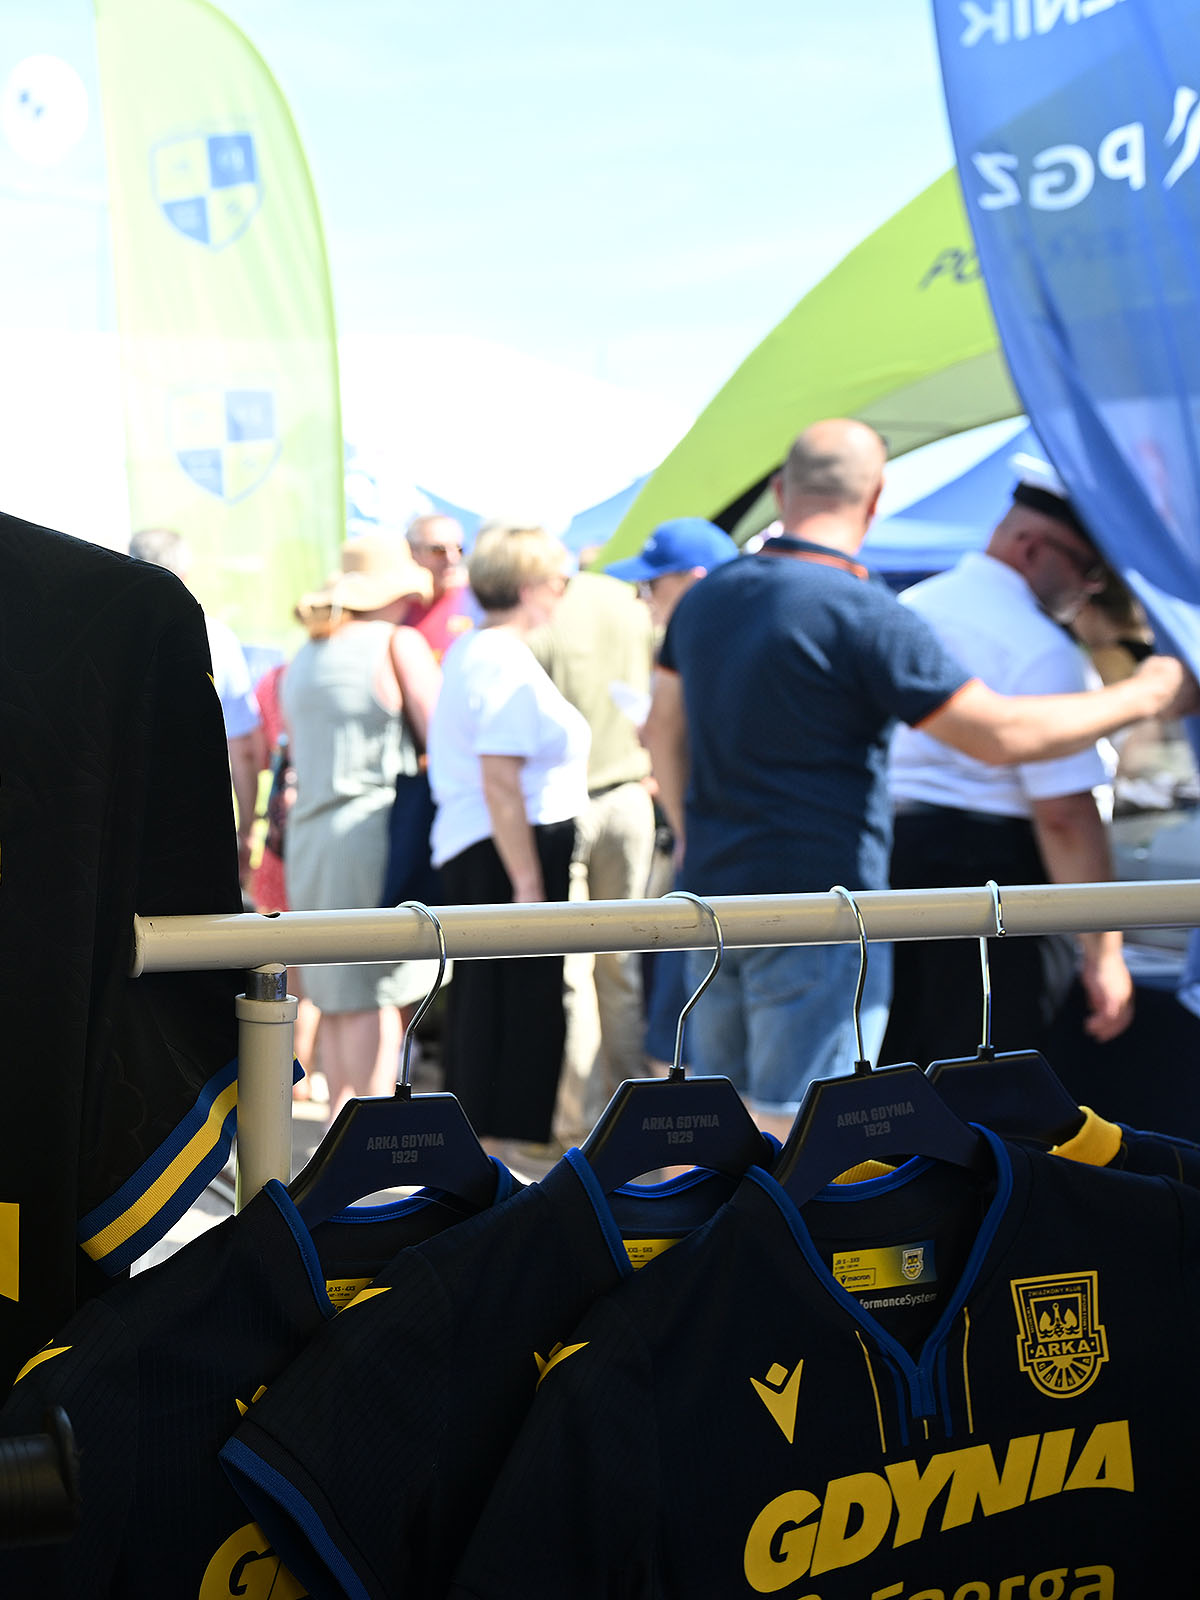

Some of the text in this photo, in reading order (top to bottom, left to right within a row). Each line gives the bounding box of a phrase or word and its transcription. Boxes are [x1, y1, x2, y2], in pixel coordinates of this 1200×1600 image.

[642, 1114, 720, 1130] ARKA GDYNIA
[837, 1101, 915, 1128] ARKA GDYNIA
[667, 1131, 694, 1144] 1929
[864, 1121, 891, 1137] 1929
[367, 1133, 445, 1151] ARKA GDYNIA
[392, 1150, 418, 1164] 1929
[1035, 1339, 1091, 1357] ARKA
[743, 1419, 1136, 1594] GDYNIA
